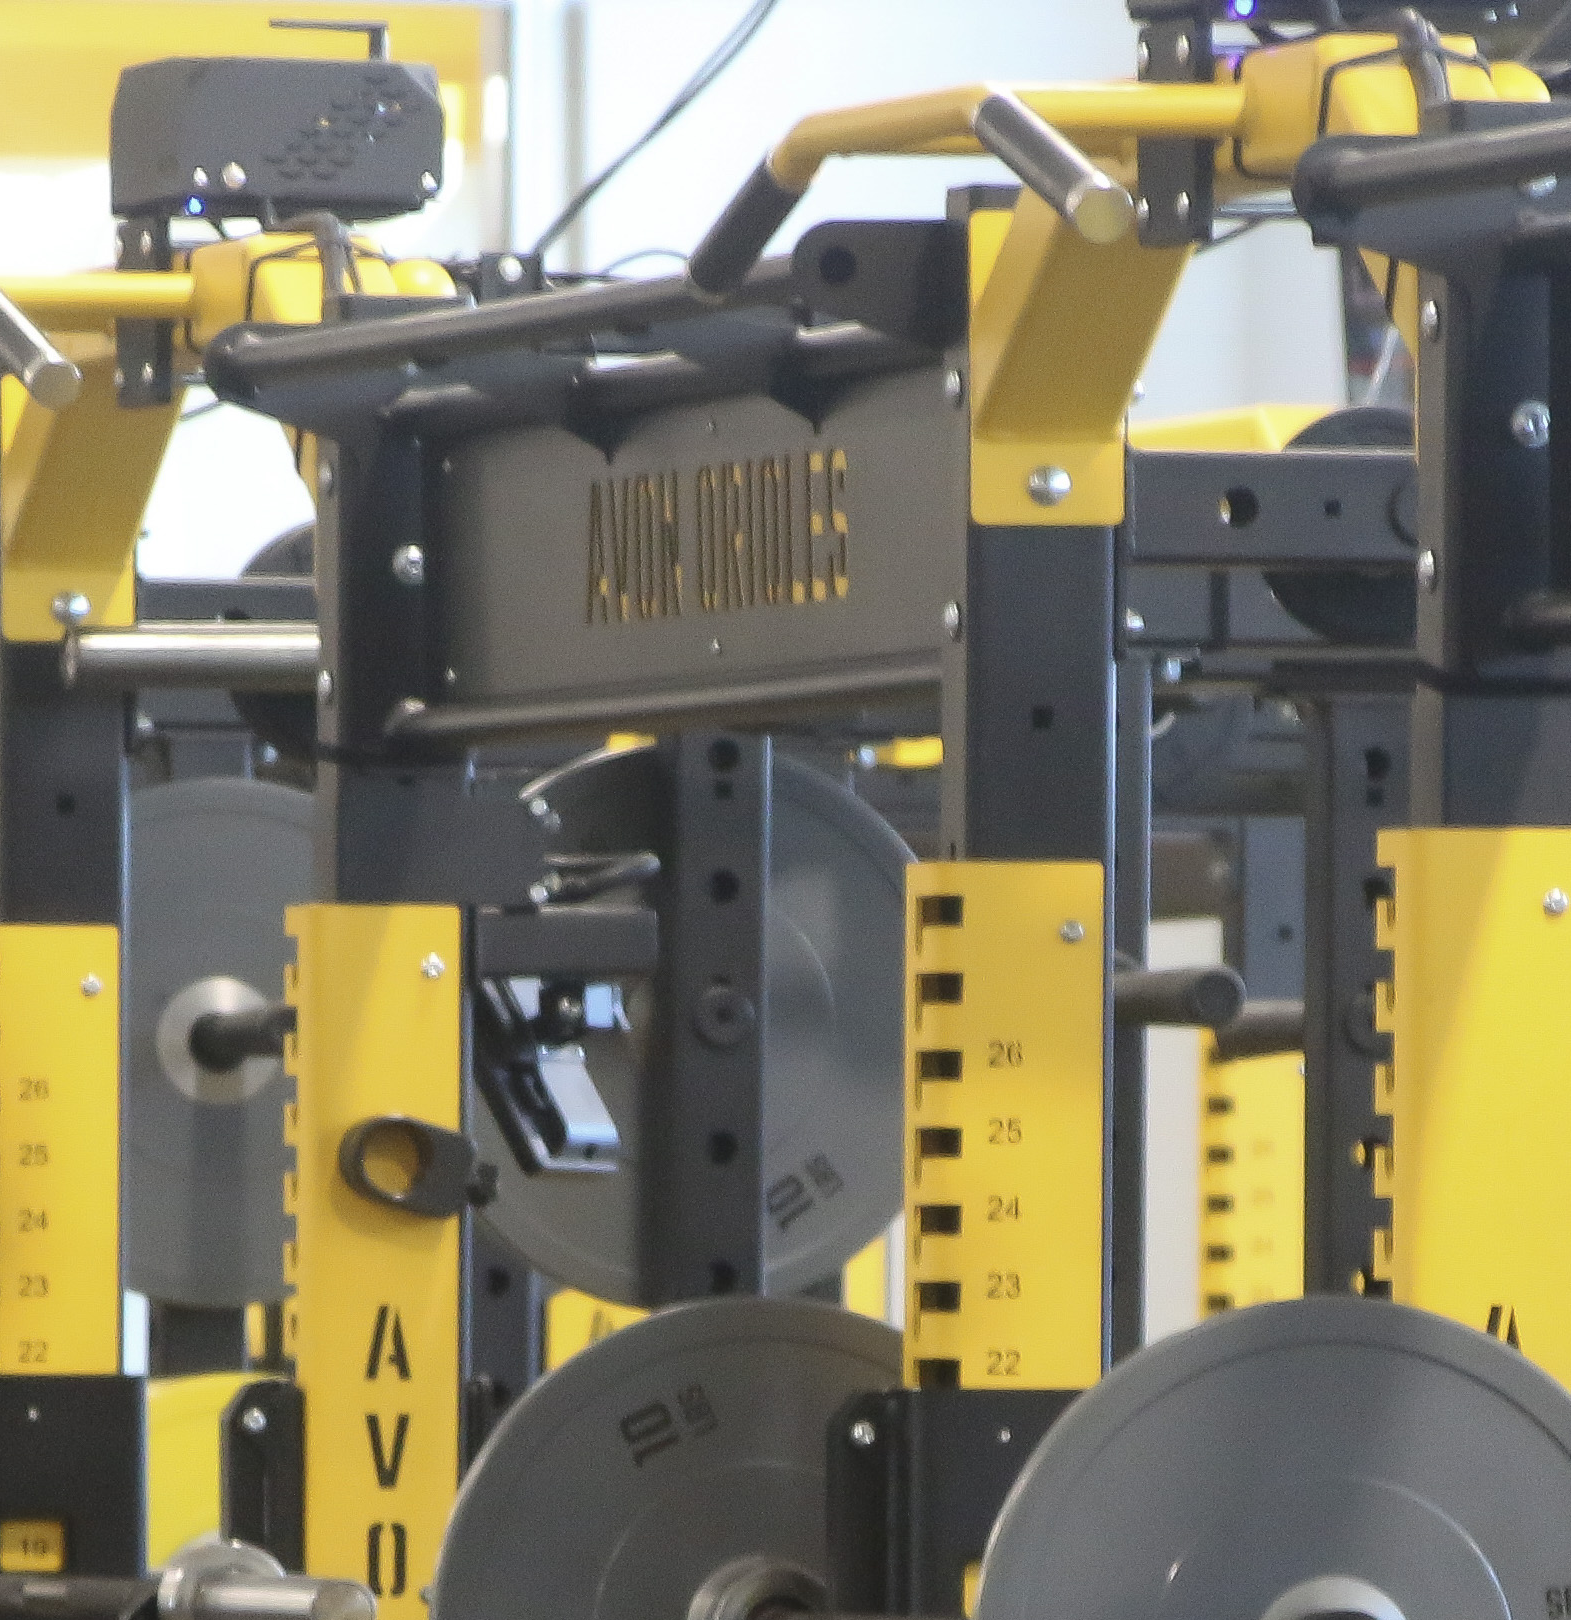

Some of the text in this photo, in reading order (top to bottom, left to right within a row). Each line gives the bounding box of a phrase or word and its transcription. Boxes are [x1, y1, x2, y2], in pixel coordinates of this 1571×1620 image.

[988, 1119, 1022, 1146] 25
[987, 1196, 1021, 1221] 24
[986, 1274, 1022, 1299] 23
[986, 1352, 1021, 1376] 22
[619, 1400, 680, 1468] 10
